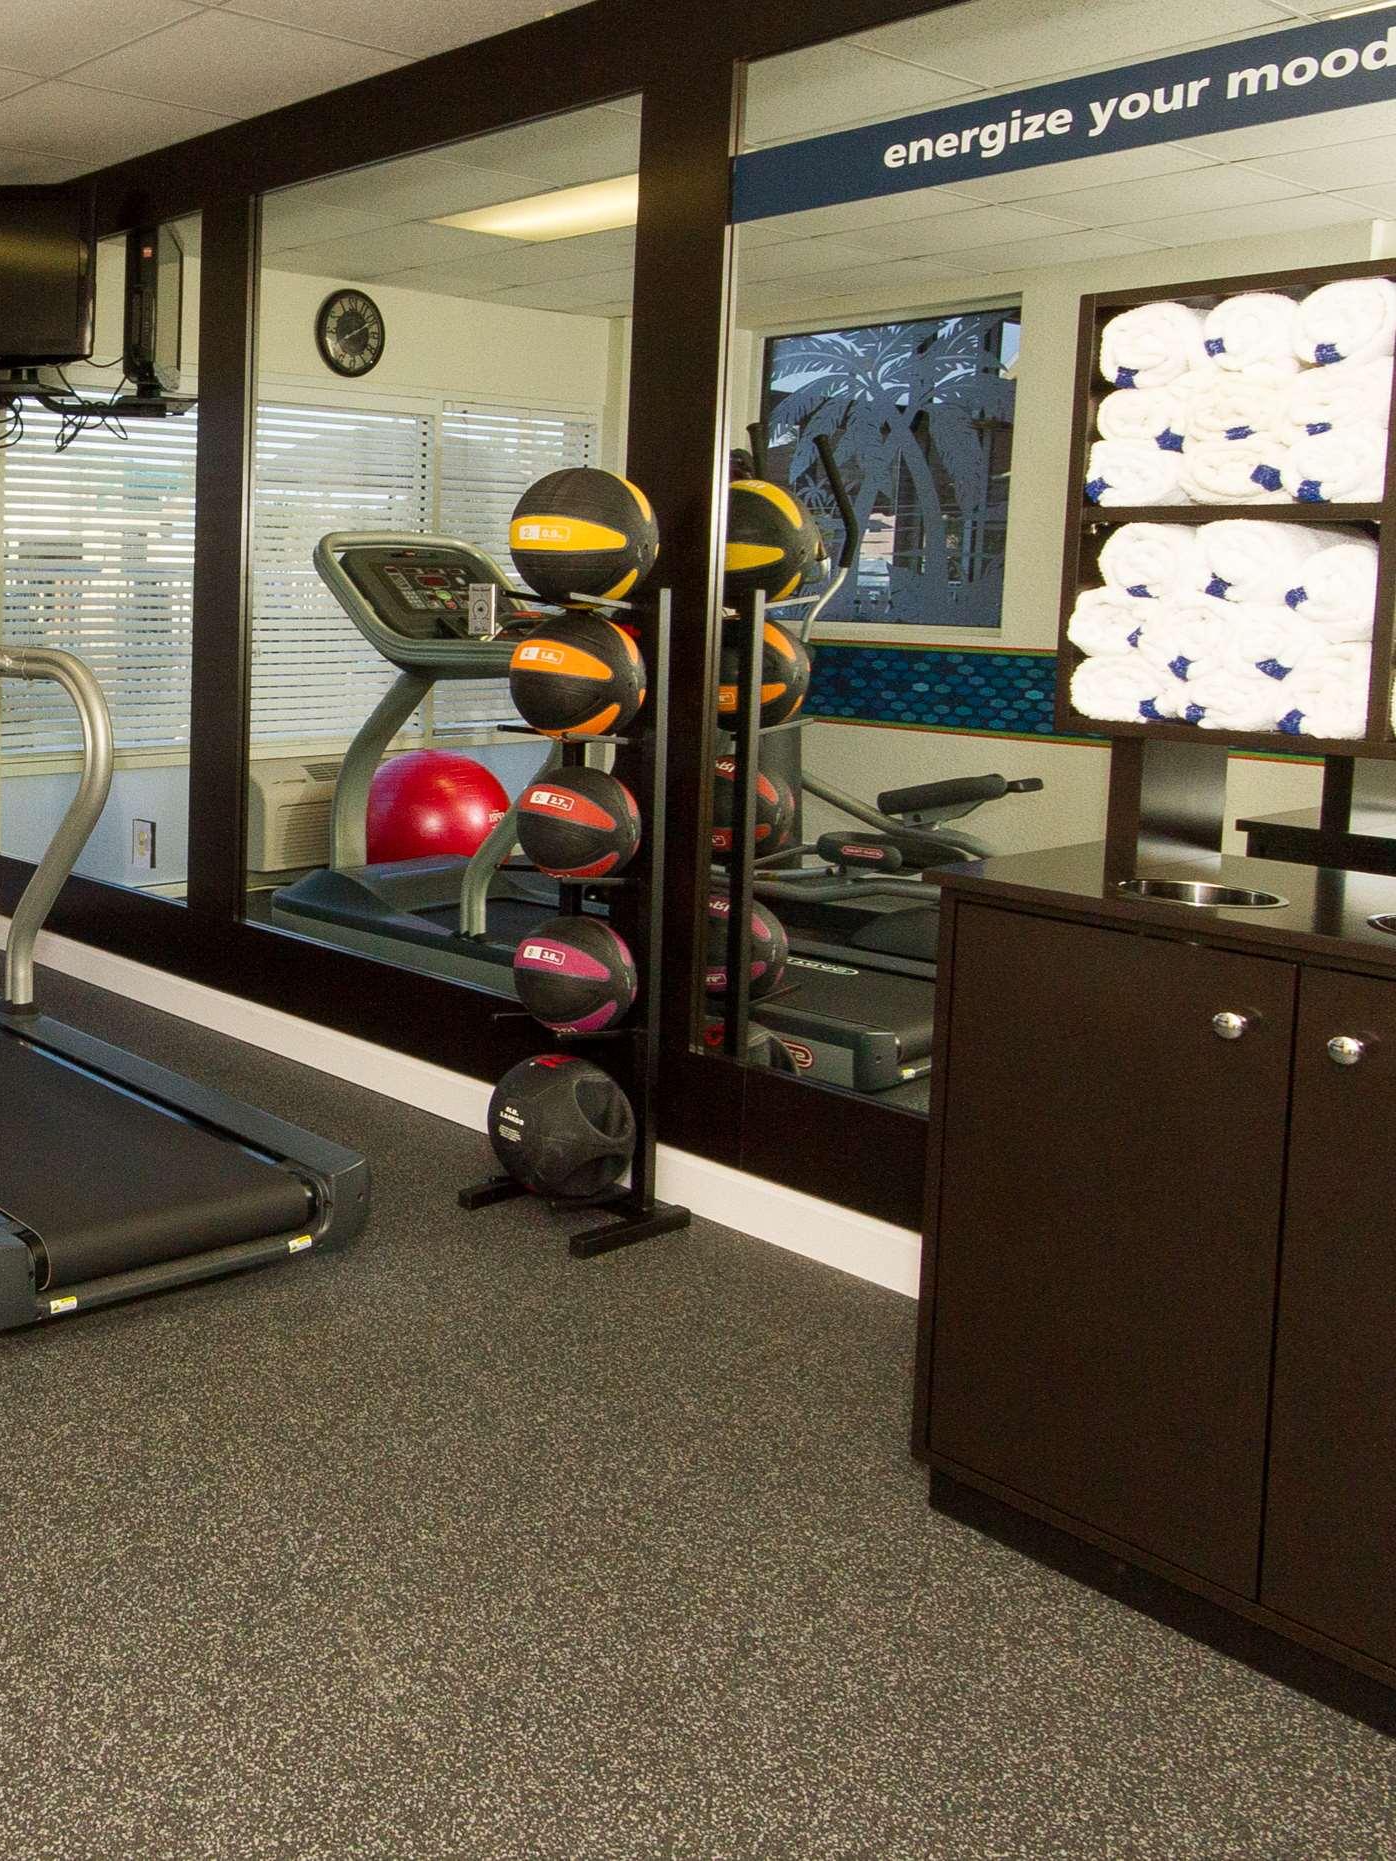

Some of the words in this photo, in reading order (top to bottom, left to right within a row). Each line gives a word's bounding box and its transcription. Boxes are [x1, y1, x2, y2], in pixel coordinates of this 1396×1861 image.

[883, 108, 1072, 169] energize
[1088, 77, 1211, 137] your
[1226, 26, 1396, 99] mood
